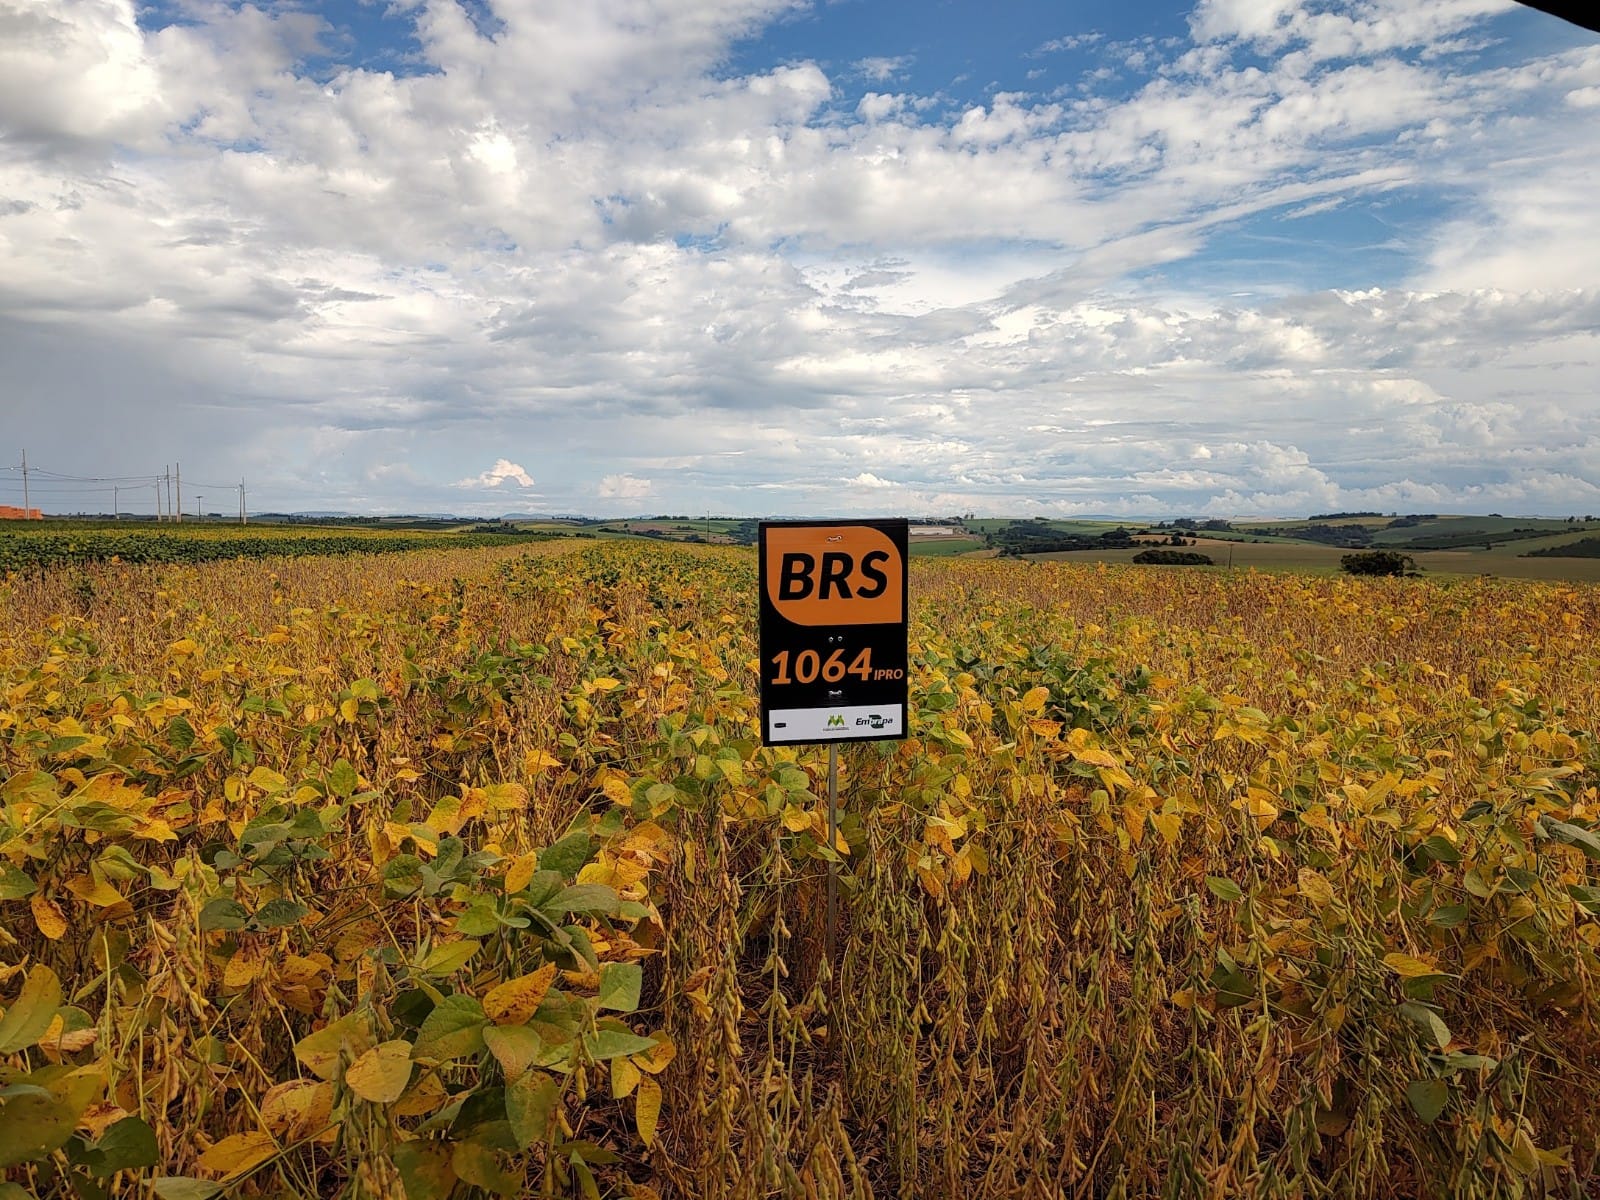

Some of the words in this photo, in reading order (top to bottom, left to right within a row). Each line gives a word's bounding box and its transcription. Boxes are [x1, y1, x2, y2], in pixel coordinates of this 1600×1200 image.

[779, 550, 890, 600] BRS
[771, 647, 872, 685] 1064
[874, 668, 904, 681] IPRO
